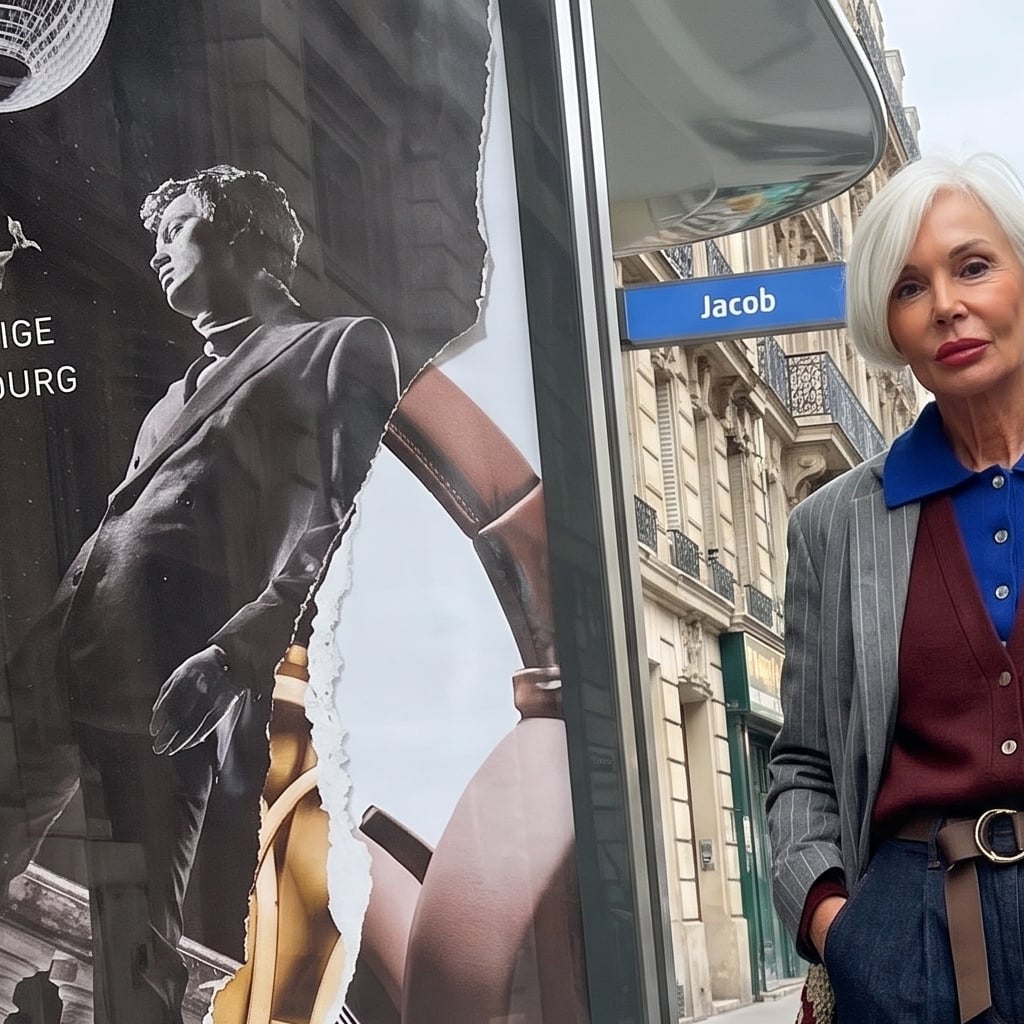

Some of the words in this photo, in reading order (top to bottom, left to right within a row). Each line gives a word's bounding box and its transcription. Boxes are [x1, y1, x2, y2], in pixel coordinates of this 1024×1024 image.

[701, 286, 776, 319] Jacob
[0, 316, 55, 349] IGE
[0, 365, 77, 400] URG
